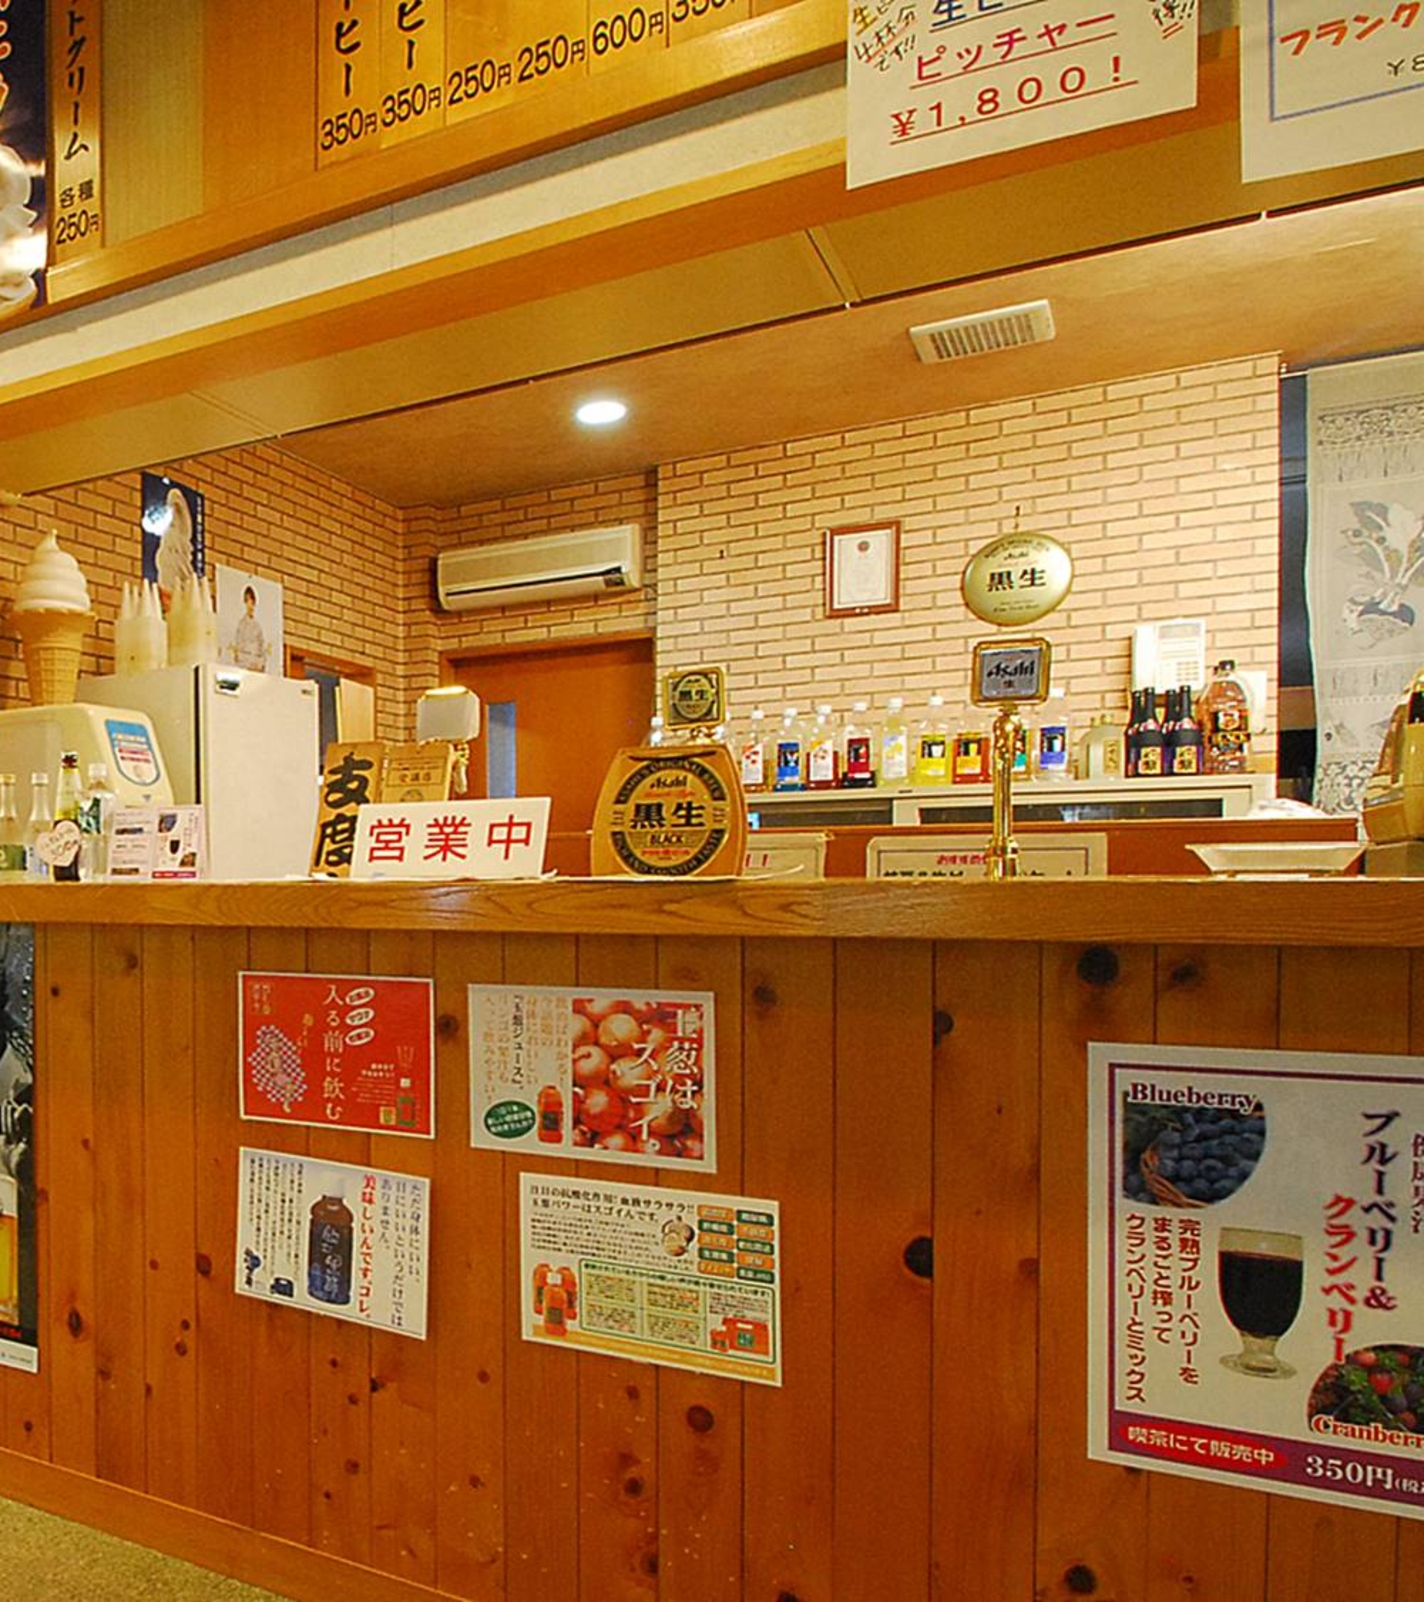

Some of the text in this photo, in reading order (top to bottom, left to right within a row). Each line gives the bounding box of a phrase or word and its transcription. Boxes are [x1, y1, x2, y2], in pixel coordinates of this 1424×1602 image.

[333, 0, 362, 98] ヒー
[592, 8, 664, 56] 600円
[916, 14, 1116, 82] ピッチャー
[517, 35, 586, 83] 250円
[381, 85, 441, 129] 350円
[447, 63, 512, 107] 250円
[320, 108, 377, 151] 350円
[59, 180, 94, 209] 各種
[55, 210, 100, 245] 250円
[987, 567, 1046, 592] 黒生
[987, 660, 1035, 679] Asahi
[315, 752, 375, 878] 支度
[368, 814, 533, 862] 営業中
[630, 801, 706, 829] 黒生
[323, 984, 345, 1120] 入る前に飲む
[629, 1042, 662, 1151] スゴイ。
[1130, 1082, 1258, 1113] Blueberry
[1361, 1110, 1401, 1312] ブルーベリー&
[1151, 1216, 1174, 1344] まるごと搾って
[1178, 1217, 1202, 1385] 完熟ブルーベリーを
[1321, 1194, 1357, 1363] クランベリー
[1125, 1213, 1147, 1403] クランベリーとミックス
[1127, 1425, 1276, 1466] 喫茶にて販売中
